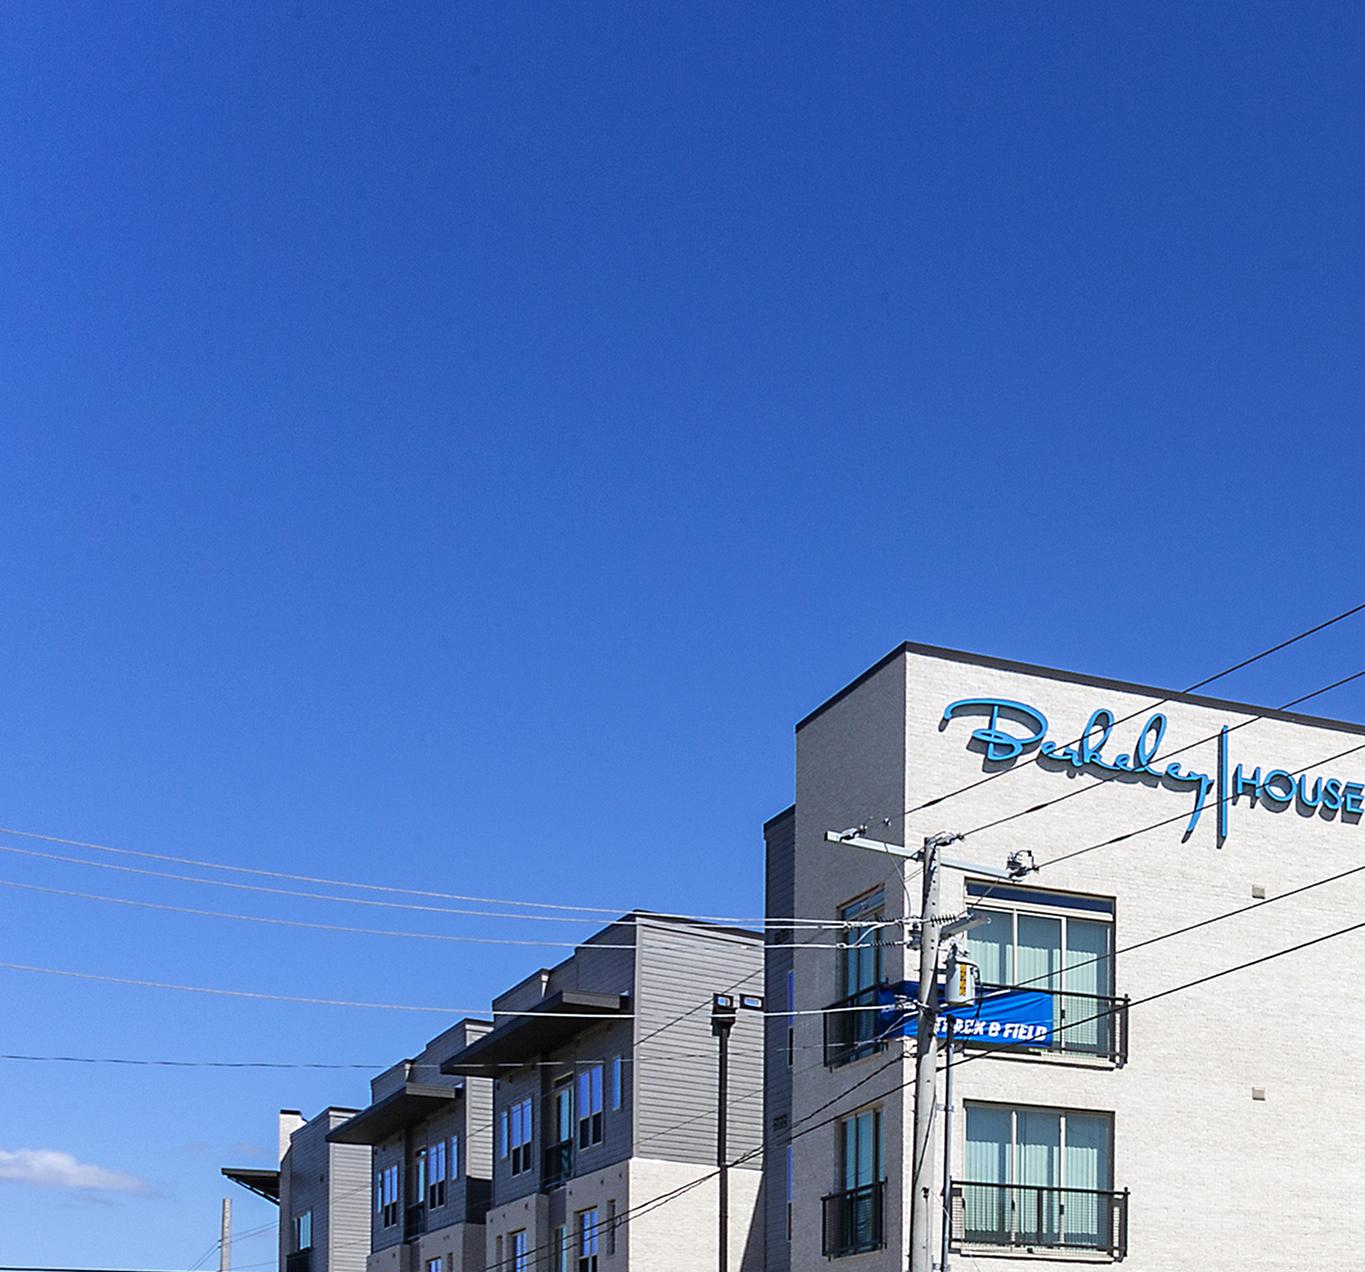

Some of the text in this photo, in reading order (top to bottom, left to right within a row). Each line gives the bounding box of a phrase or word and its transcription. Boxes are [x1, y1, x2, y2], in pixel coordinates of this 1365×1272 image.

[942, 698, 1365, 834] Berkeley HOUSE
[1003, 1023, 1048, 1041] FIELD
